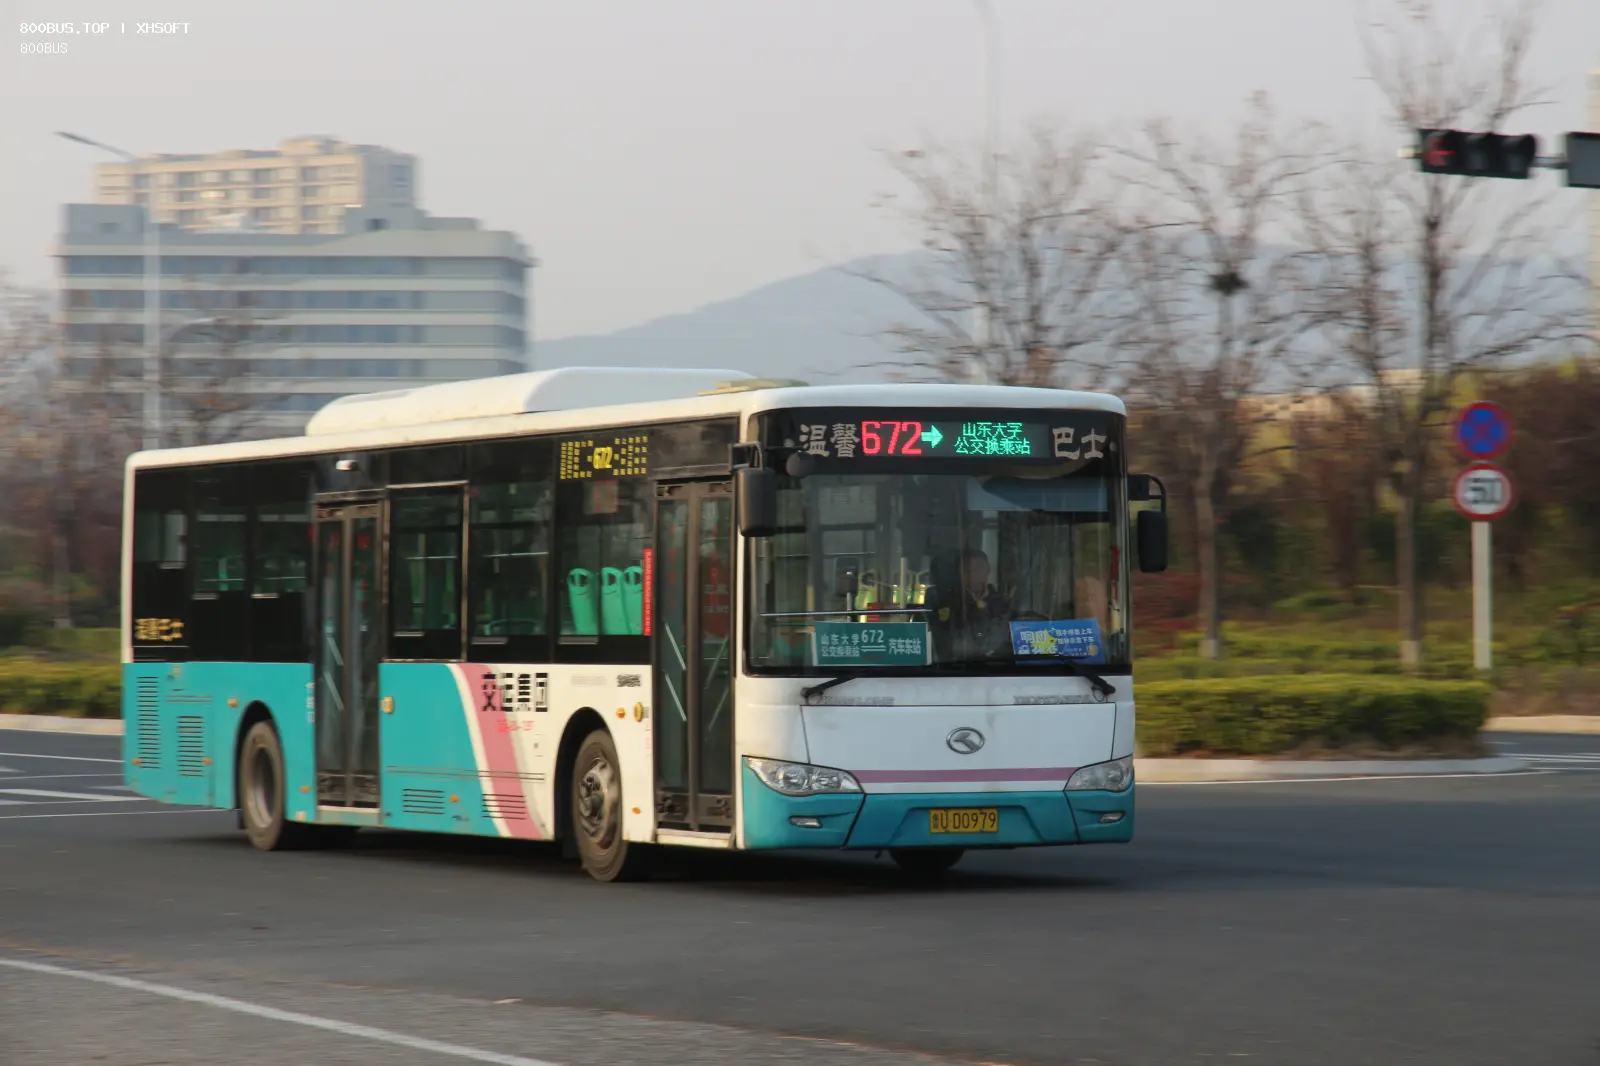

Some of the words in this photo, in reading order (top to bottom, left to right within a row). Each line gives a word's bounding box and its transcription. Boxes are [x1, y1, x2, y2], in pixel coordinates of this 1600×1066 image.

[799, 423, 860, 457] 温馨
[1052, 427, 1107, 459] 巴士
[861, 421, 923, 455] 672
[953, 437, 1031, 455] 公交换乘站
[820, 633, 860, 646] 山东大学
[861, 629, 885, 644] 672
